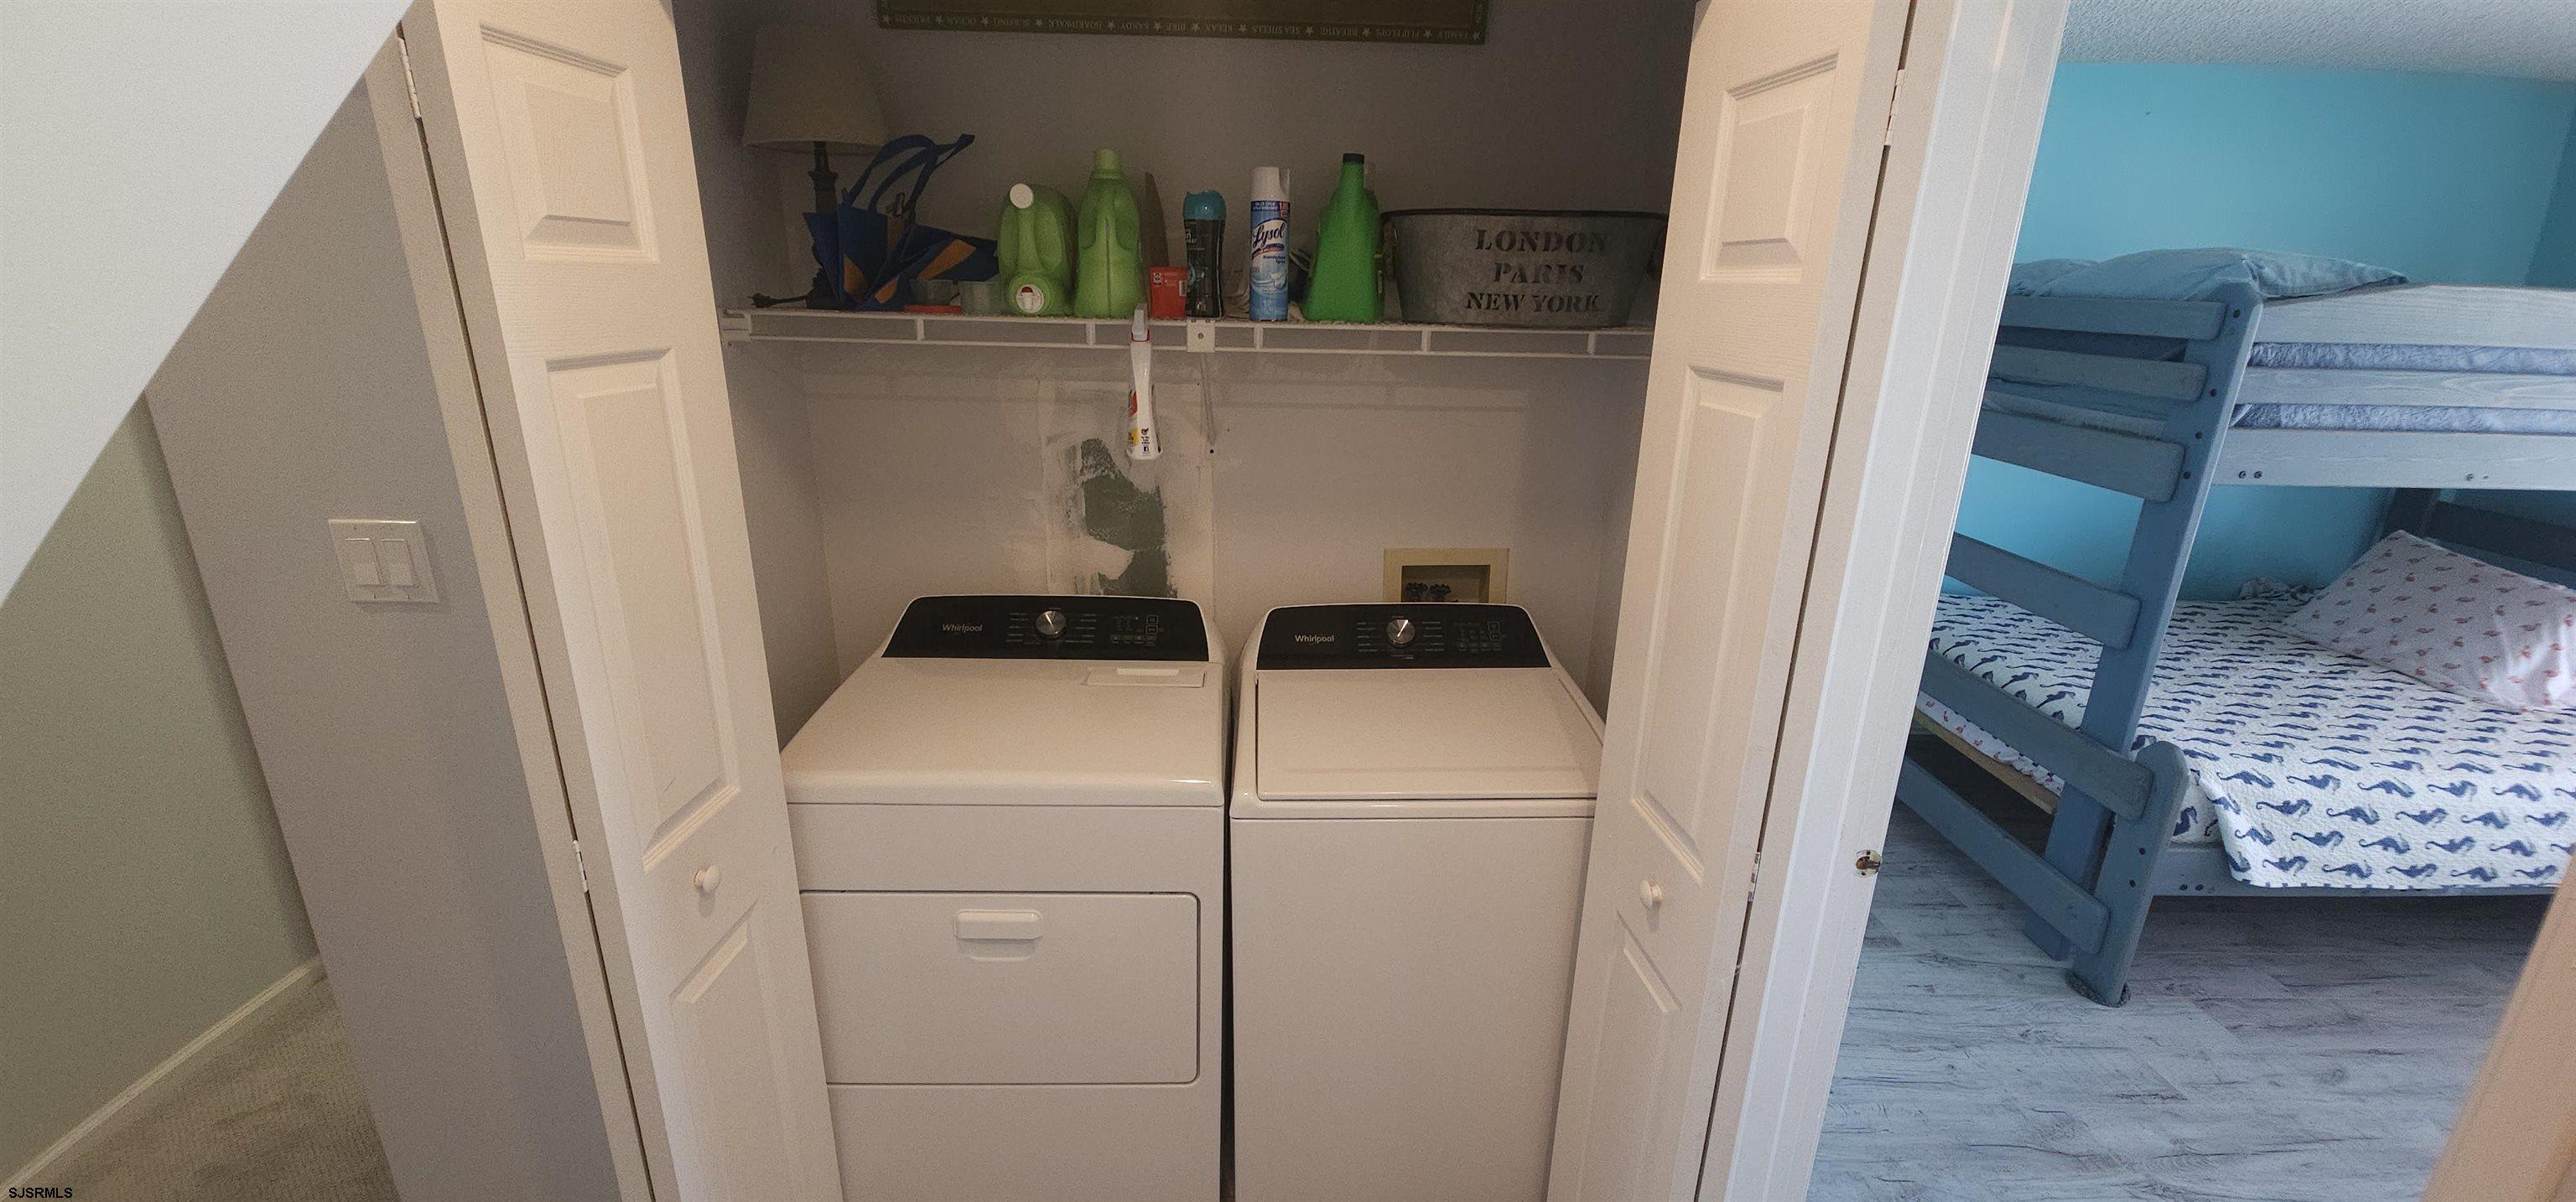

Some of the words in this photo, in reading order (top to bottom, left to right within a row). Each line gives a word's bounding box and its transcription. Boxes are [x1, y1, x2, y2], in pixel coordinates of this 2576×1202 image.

[948, 15, 976, 25] OCEAN
[994, 18, 1031, 28] SURFING
[1046, 20, 1102, 30] BOARDWALK
[1121, 21, 1149, 30] SANDY
[1205, 23, 1233, 33] RELAX
[1251, 25, 1300, 35] SEASHELLS
[1252, 222, 1286, 248] Lysol
[1474, 228, 1609, 252] LONDON
[1493, 262, 1584, 284] PARIS
[1466, 292, 1526, 311] NEW
[1531, 294, 1607, 313] YORK
[942, 623, 983, 635] Whirlpool
[1295, 634, 1334, 645] Whirlpool
